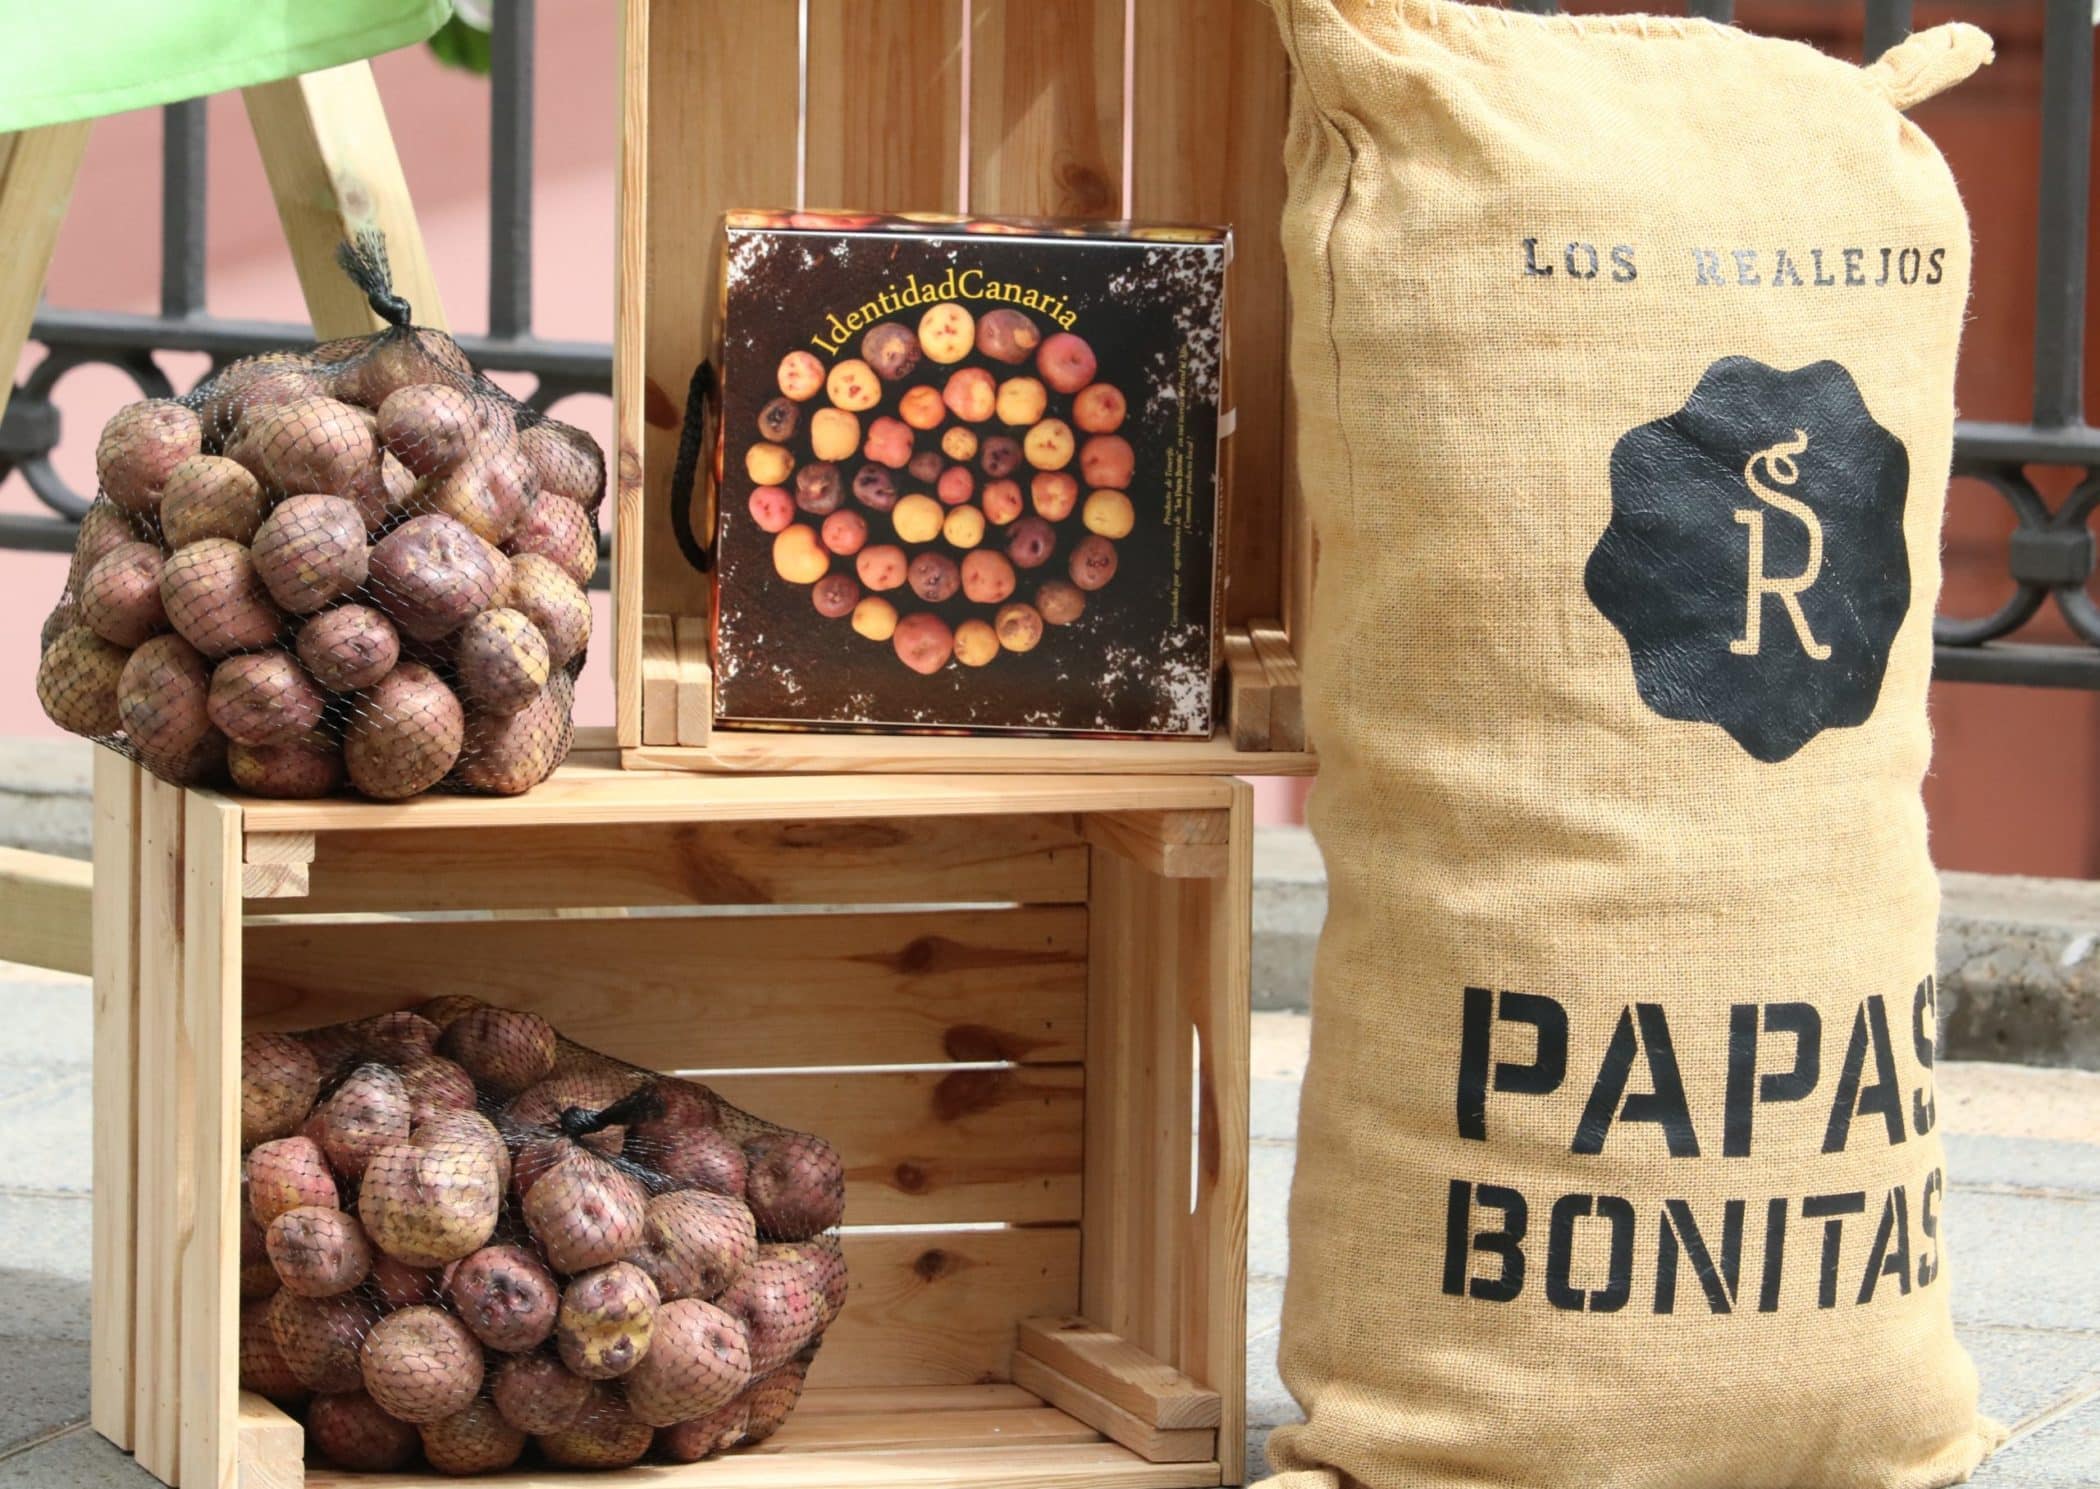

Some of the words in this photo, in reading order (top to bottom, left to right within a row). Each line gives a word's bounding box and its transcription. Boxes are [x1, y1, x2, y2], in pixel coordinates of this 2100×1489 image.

[1522, 237, 1639, 284] LOS
[1692, 247, 1947, 287] REALEJOS
[1456, 973, 1937, 1158] PAPAS
[1441, 1166, 1943, 1315] BONITAS
